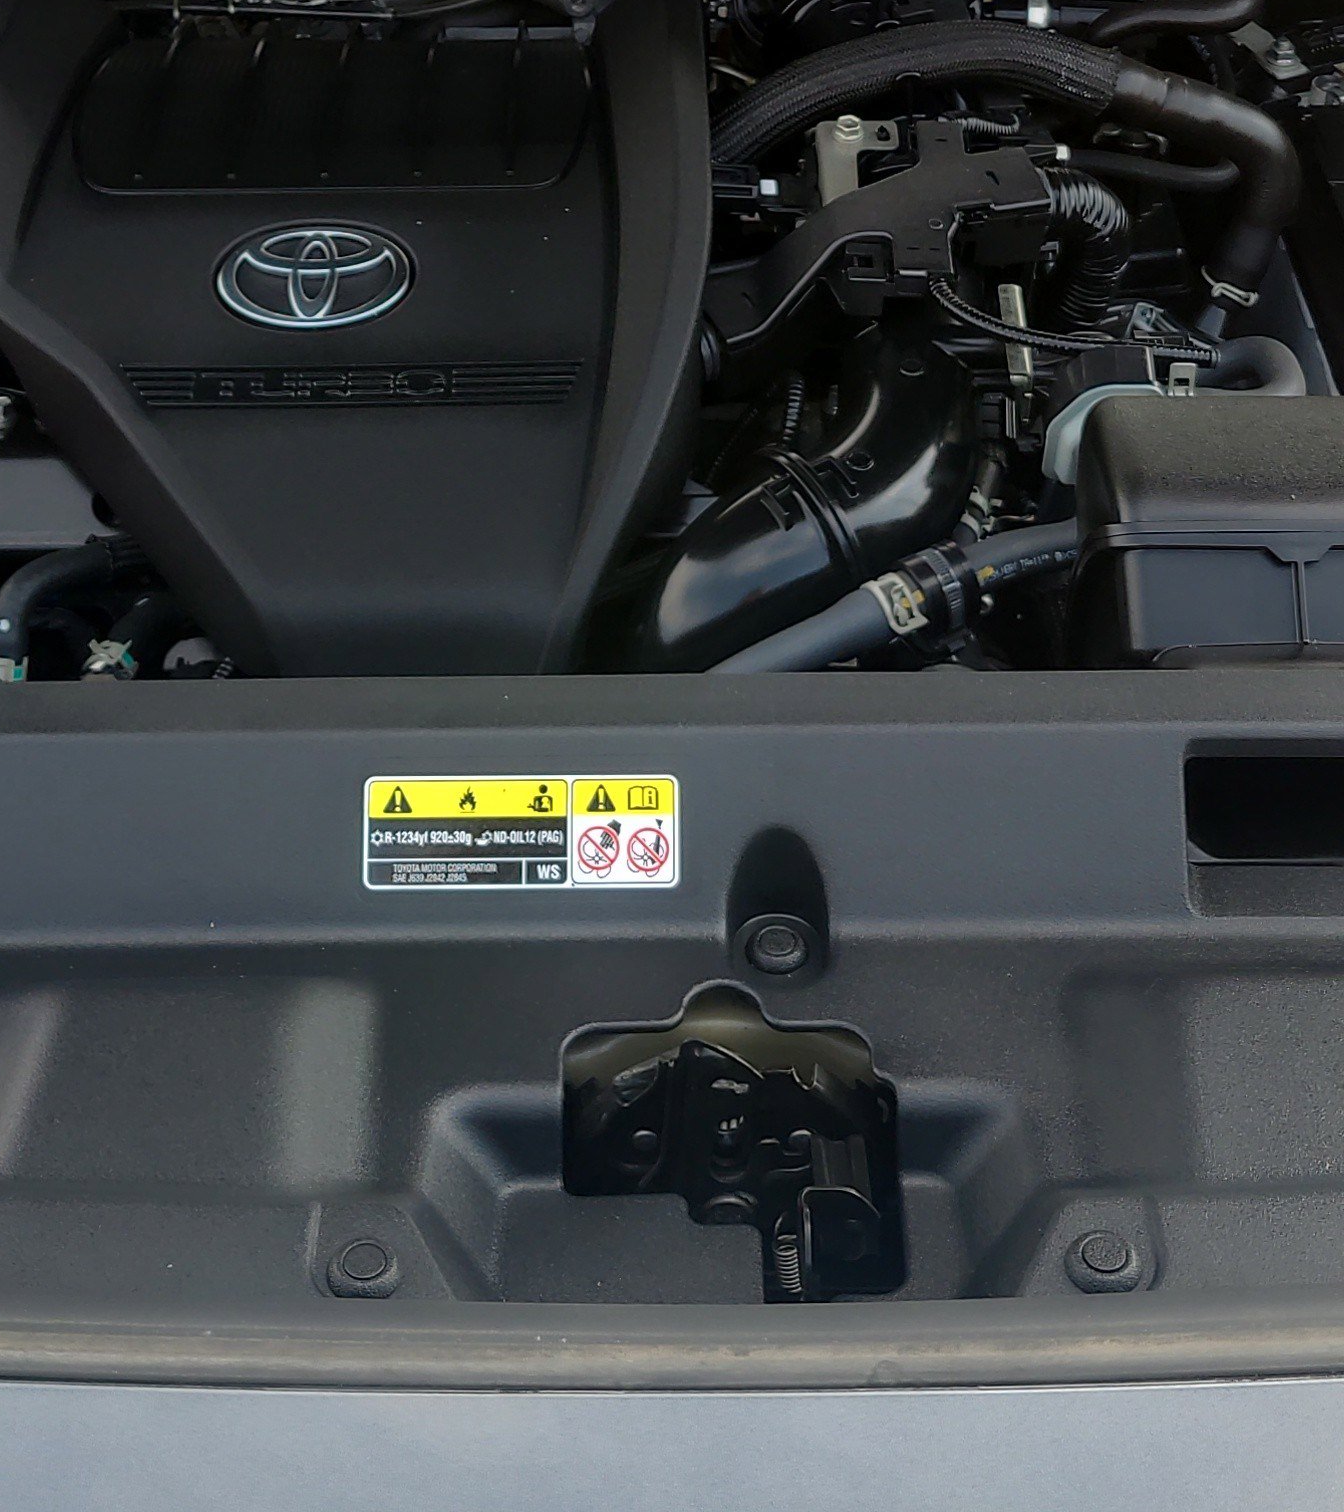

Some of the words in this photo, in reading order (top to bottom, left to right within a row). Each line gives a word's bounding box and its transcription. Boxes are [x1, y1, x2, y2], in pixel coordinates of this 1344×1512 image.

[200, 369, 447, 399] TURBO
[384, 830, 429, 847] R-1234yf
[430, 830, 473, 847] 920±30g
[493, 830, 537, 844] ND-OIL12
[537, 830, 565, 846] (PAG)
[392, 863, 421, 873] TOYOTA
[421, 863, 447, 873] MOTOR
[447, 863, 498, 874] CORPORATION
[536, 863, 561, 880] WS
[392, 873, 407, 883] SAE
